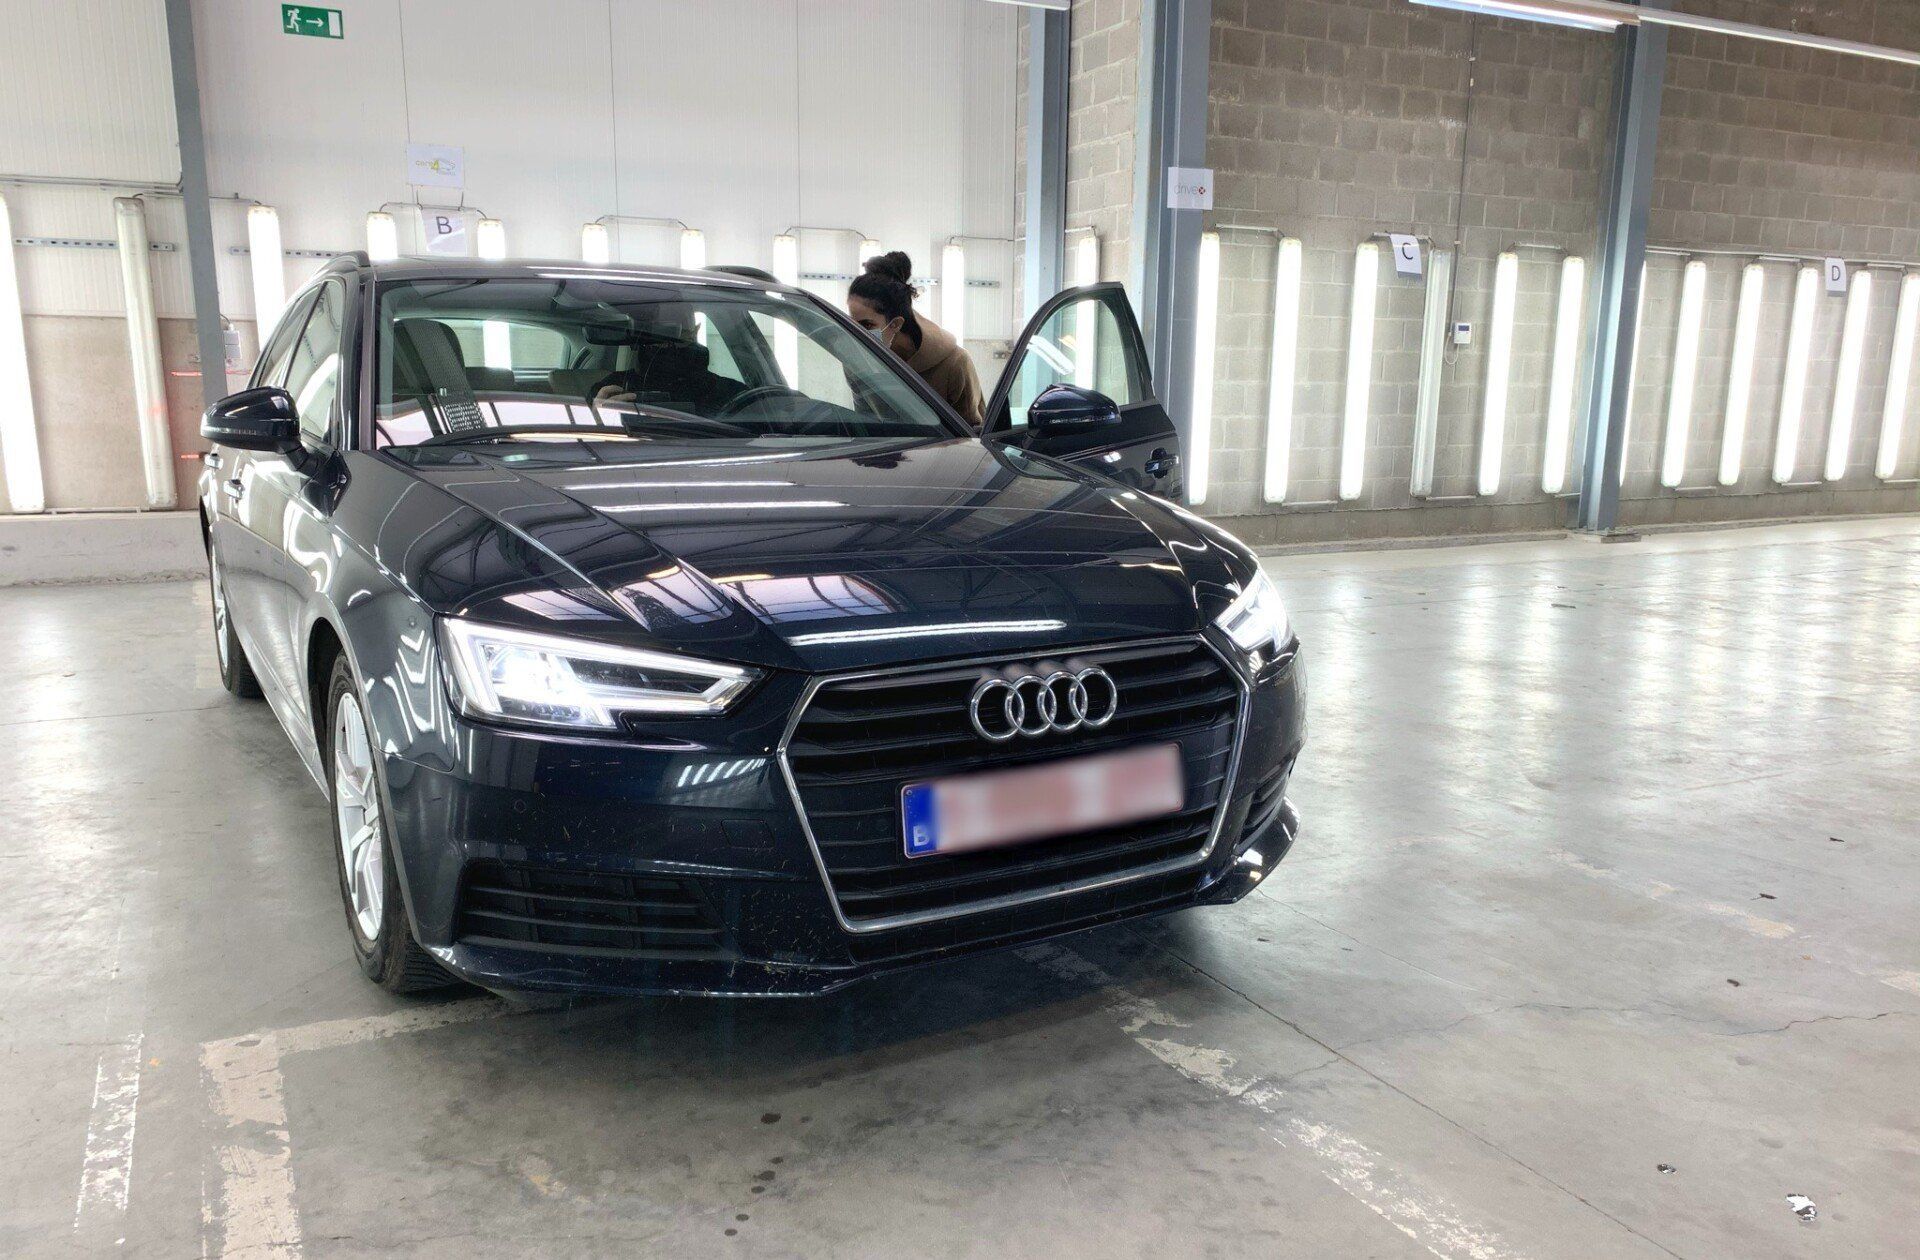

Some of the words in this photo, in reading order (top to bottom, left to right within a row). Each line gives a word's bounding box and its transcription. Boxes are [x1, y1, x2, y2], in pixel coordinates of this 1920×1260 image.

[436, 216, 452, 234] B
[1402, 242, 1413, 260] C
[1831, 265, 1841, 281] D
[913, 825, 930, 847] B
